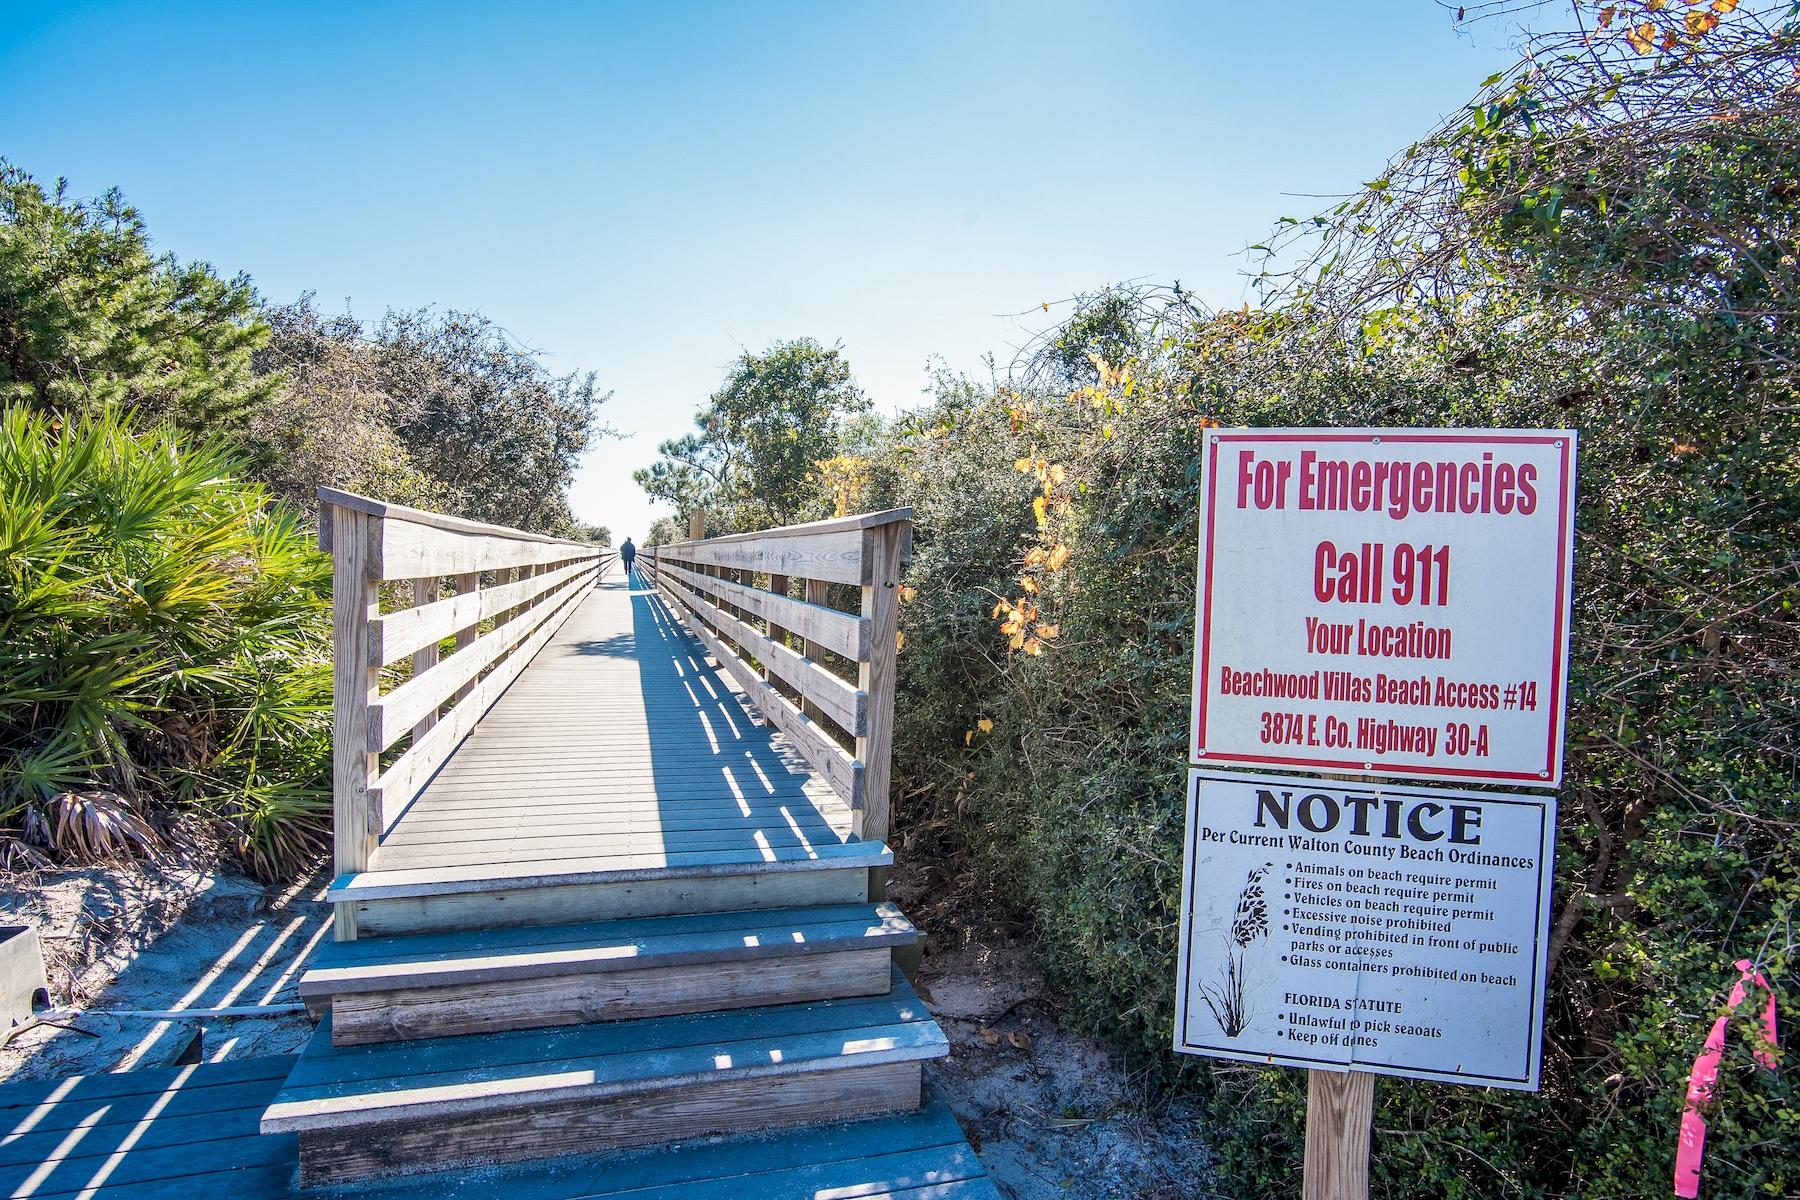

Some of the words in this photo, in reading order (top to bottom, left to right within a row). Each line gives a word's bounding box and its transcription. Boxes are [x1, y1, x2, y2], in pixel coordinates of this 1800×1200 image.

[1237, 451, 1291, 509] For
[1299, 451, 1537, 520] Emergencies
[1314, 541, 1383, 603] Call
[1392, 543, 1449, 606] 911
[1305, 617, 1353, 654] Your
[1358, 619, 1451, 659] Location
[1221, 666, 1318, 699] Beachwood
[1324, 671, 1371, 702] Villas
[1376, 674, 1430, 706] Beach
[1435, 677, 1499, 710] Access
[1504, 681, 1536, 711] #14
[1261, 712, 1303, 745] 3874
[1308, 715, 1320, 746] E.
[1325, 716, 1352, 748] Co.
[1357, 718, 1437, 757] Highway
[1446, 723, 1488, 756] 30-A
[1254, 790, 1482, 845] NOTICE
[1202, 827, 1225, 842] Per
[1230, 830, 1284, 848] Current
[1289, 835, 1339, 853] Walton
[1345, 841, 1395, 860] County
[1400, 845, 1444, 862] Beach
[1449, 849, 1534, 869] Ordinances
[1295, 862, 1345, 877] Animals
[1349, 869, 1364, 878] on
[1368, 868, 1402, 882] beach
[1406, 874, 1451, 886] require
[1455, 878, 1497, 890] permit
[1295, 878, 1323, 890] Fires
[1327, 883, 1342, 892] on
[1346, 883, 1380, 895] beach
[1384, 887, 1429, 899] require
[1433, 891, 1474, 903] permit
[1293, 908, 1347, 923] Excessive
[1351, 914, 1382, 926] noise
[1386, 917, 1451, 933] prohibited
[1294, 892, 1342, 907] Vehicles
[1346, 900, 1361, 909] on
[1366, 900, 1399, 912] beach
[1404, 904, 1448, 917] require
[1452, 909, 1494, 921] permit
[1291, 940, 1325, 953] parks
[1328, 944, 1341, 954] or
[1345, 946, 1393, 958] accesses
[1292, 923, 1341, 941] Vending
[1345, 927, 1408, 944] prohibited
[1412, 934, 1424, 946] in
[1428, 936, 1459, 949] front
[1463, 939, 1476, 950] of
[1479, 941, 1518, 954] public
[1290, 954, 1322, 969] Glass
[1325, 959, 1388, 973] containers
[1392, 965, 1457, 981] prohibited
[1462, 972, 1477, 982] on
[1481, 973, 1517, 986] beach
[1284, 992, 1340, 1010] FLORIDA
[1345, 999, 1402, 1014] STATUTE
[1288, 1029, 1317, 1045] Keep
[1321, 1033, 1338, 1046] off
[1289, 1012, 1346, 1029] Unlawful
[1364, 1019, 1391, 1033] pick
[1394, 1024, 1442, 1038] seaoats
